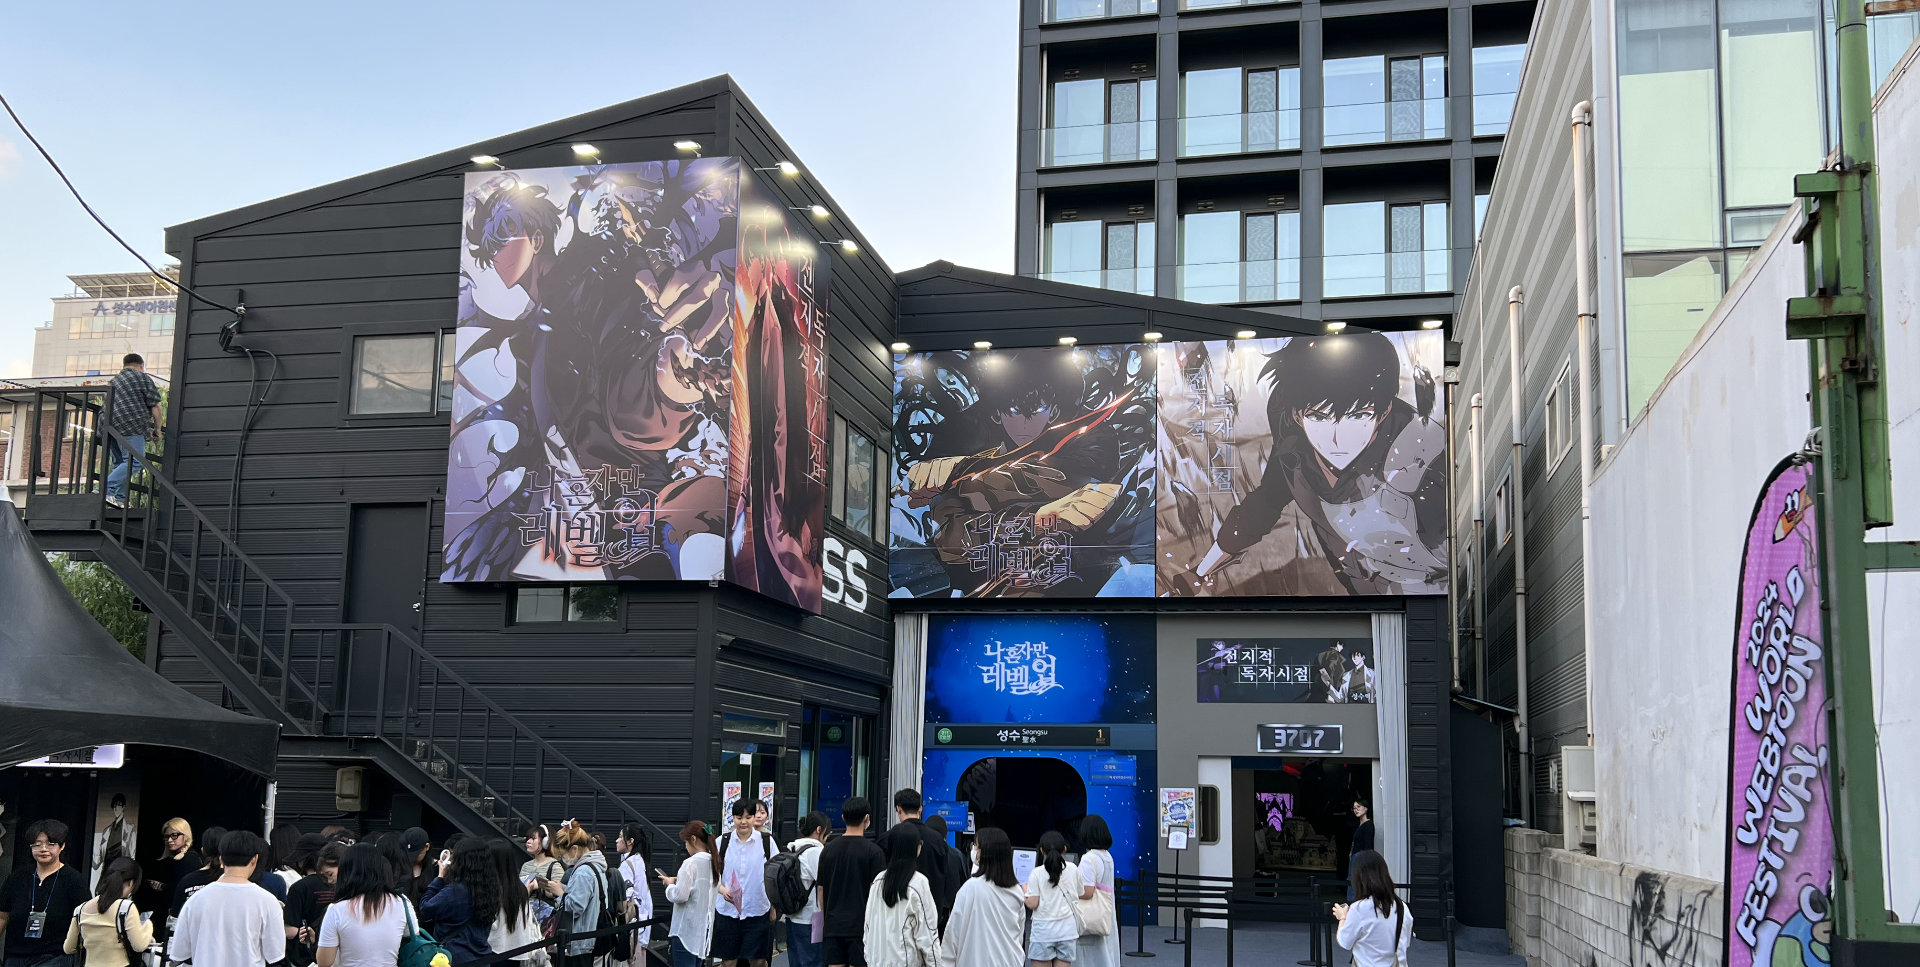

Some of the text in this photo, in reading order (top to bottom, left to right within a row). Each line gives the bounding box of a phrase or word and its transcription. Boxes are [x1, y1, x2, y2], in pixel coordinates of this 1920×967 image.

[1186, 368, 1207, 441] 전지적
[1211, 395, 1234, 491] 독자시점
[511, 489, 666, 569] 레벨업
[961, 532, 1082, 590] 레벨업
[1745, 565, 1806, 733] WORLD
[1746, 579, 1780, 668] 2024
[977, 654, 1065, 696] 레벨업
[1224, 648, 1272, 665] 전지적
[1241, 666, 1309, 682] 독자시점
[997, 729, 1020, 742] 성수
[1021, 728, 1048, 737] Seongsu
[1097, 728, 1103, 739] 1
[1274, 728, 1326, 748] 3707
[1735, 634, 1823, 846] WEBTOON
[1735, 744, 1828, 947] FESTIVAL
